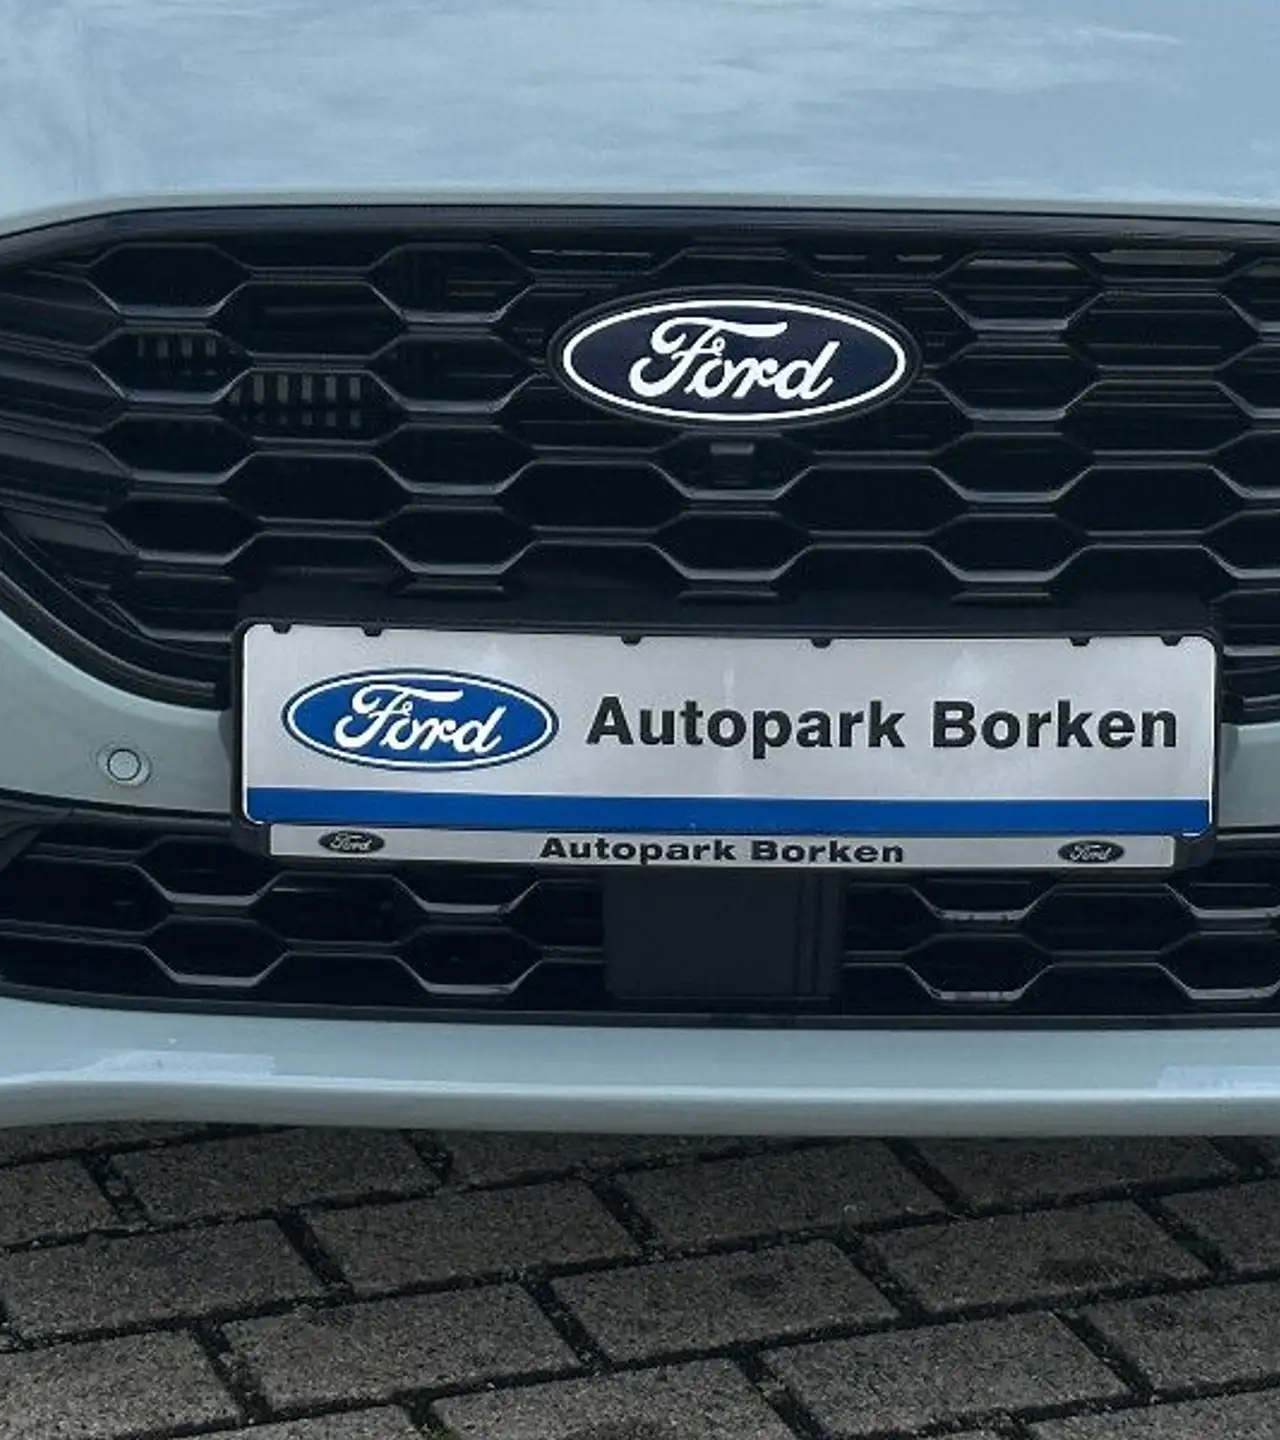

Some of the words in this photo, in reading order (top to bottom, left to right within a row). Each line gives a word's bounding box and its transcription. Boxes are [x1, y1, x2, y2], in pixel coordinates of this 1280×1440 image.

[627, 316, 841, 400] Ford
[334, 683, 507, 754] Ford
[585, 695, 906, 760] Autopark
[932, 699, 1178, 750] Borken
[330, 834, 373, 851] Ford
[539, 836, 736, 865] Autopark
[750, 839, 905, 864] Borken
[1069, 844, 1112, 861] Ford
